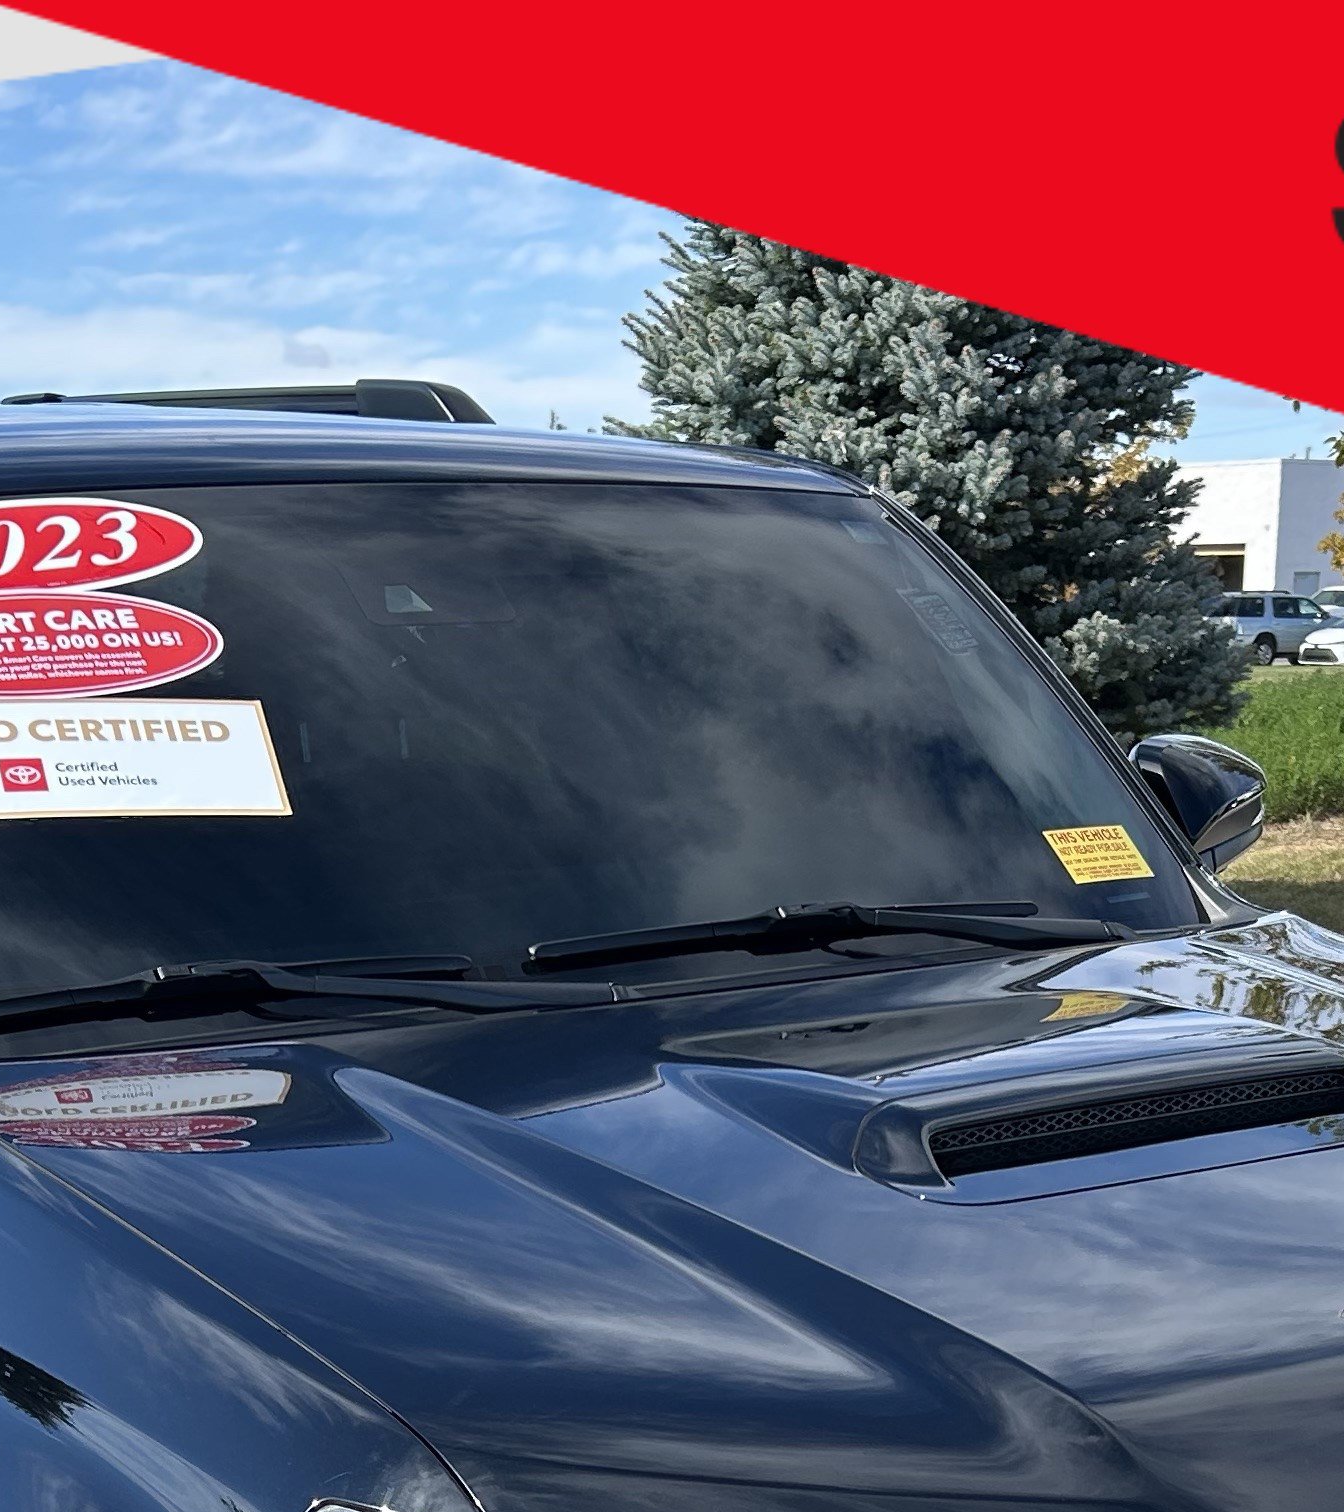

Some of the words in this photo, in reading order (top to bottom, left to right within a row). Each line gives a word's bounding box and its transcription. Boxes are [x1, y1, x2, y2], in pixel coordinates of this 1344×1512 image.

[43, 608, 140, 631] CARE
[19, 633, 100, 653] 25,000
[102, 632, 141, 648] ON
[142, 630, 183, 647] US!
[28, 718, 231, 742] CERTIFIED
[55, 761, 118, 774] Certified
[58, 774, 97, 787] Used
[98, 774, 158, 787] Vehicles
[1049, 832, 1077, 845] THIS
[1076, 828, 1123, 843] VEHICLE
